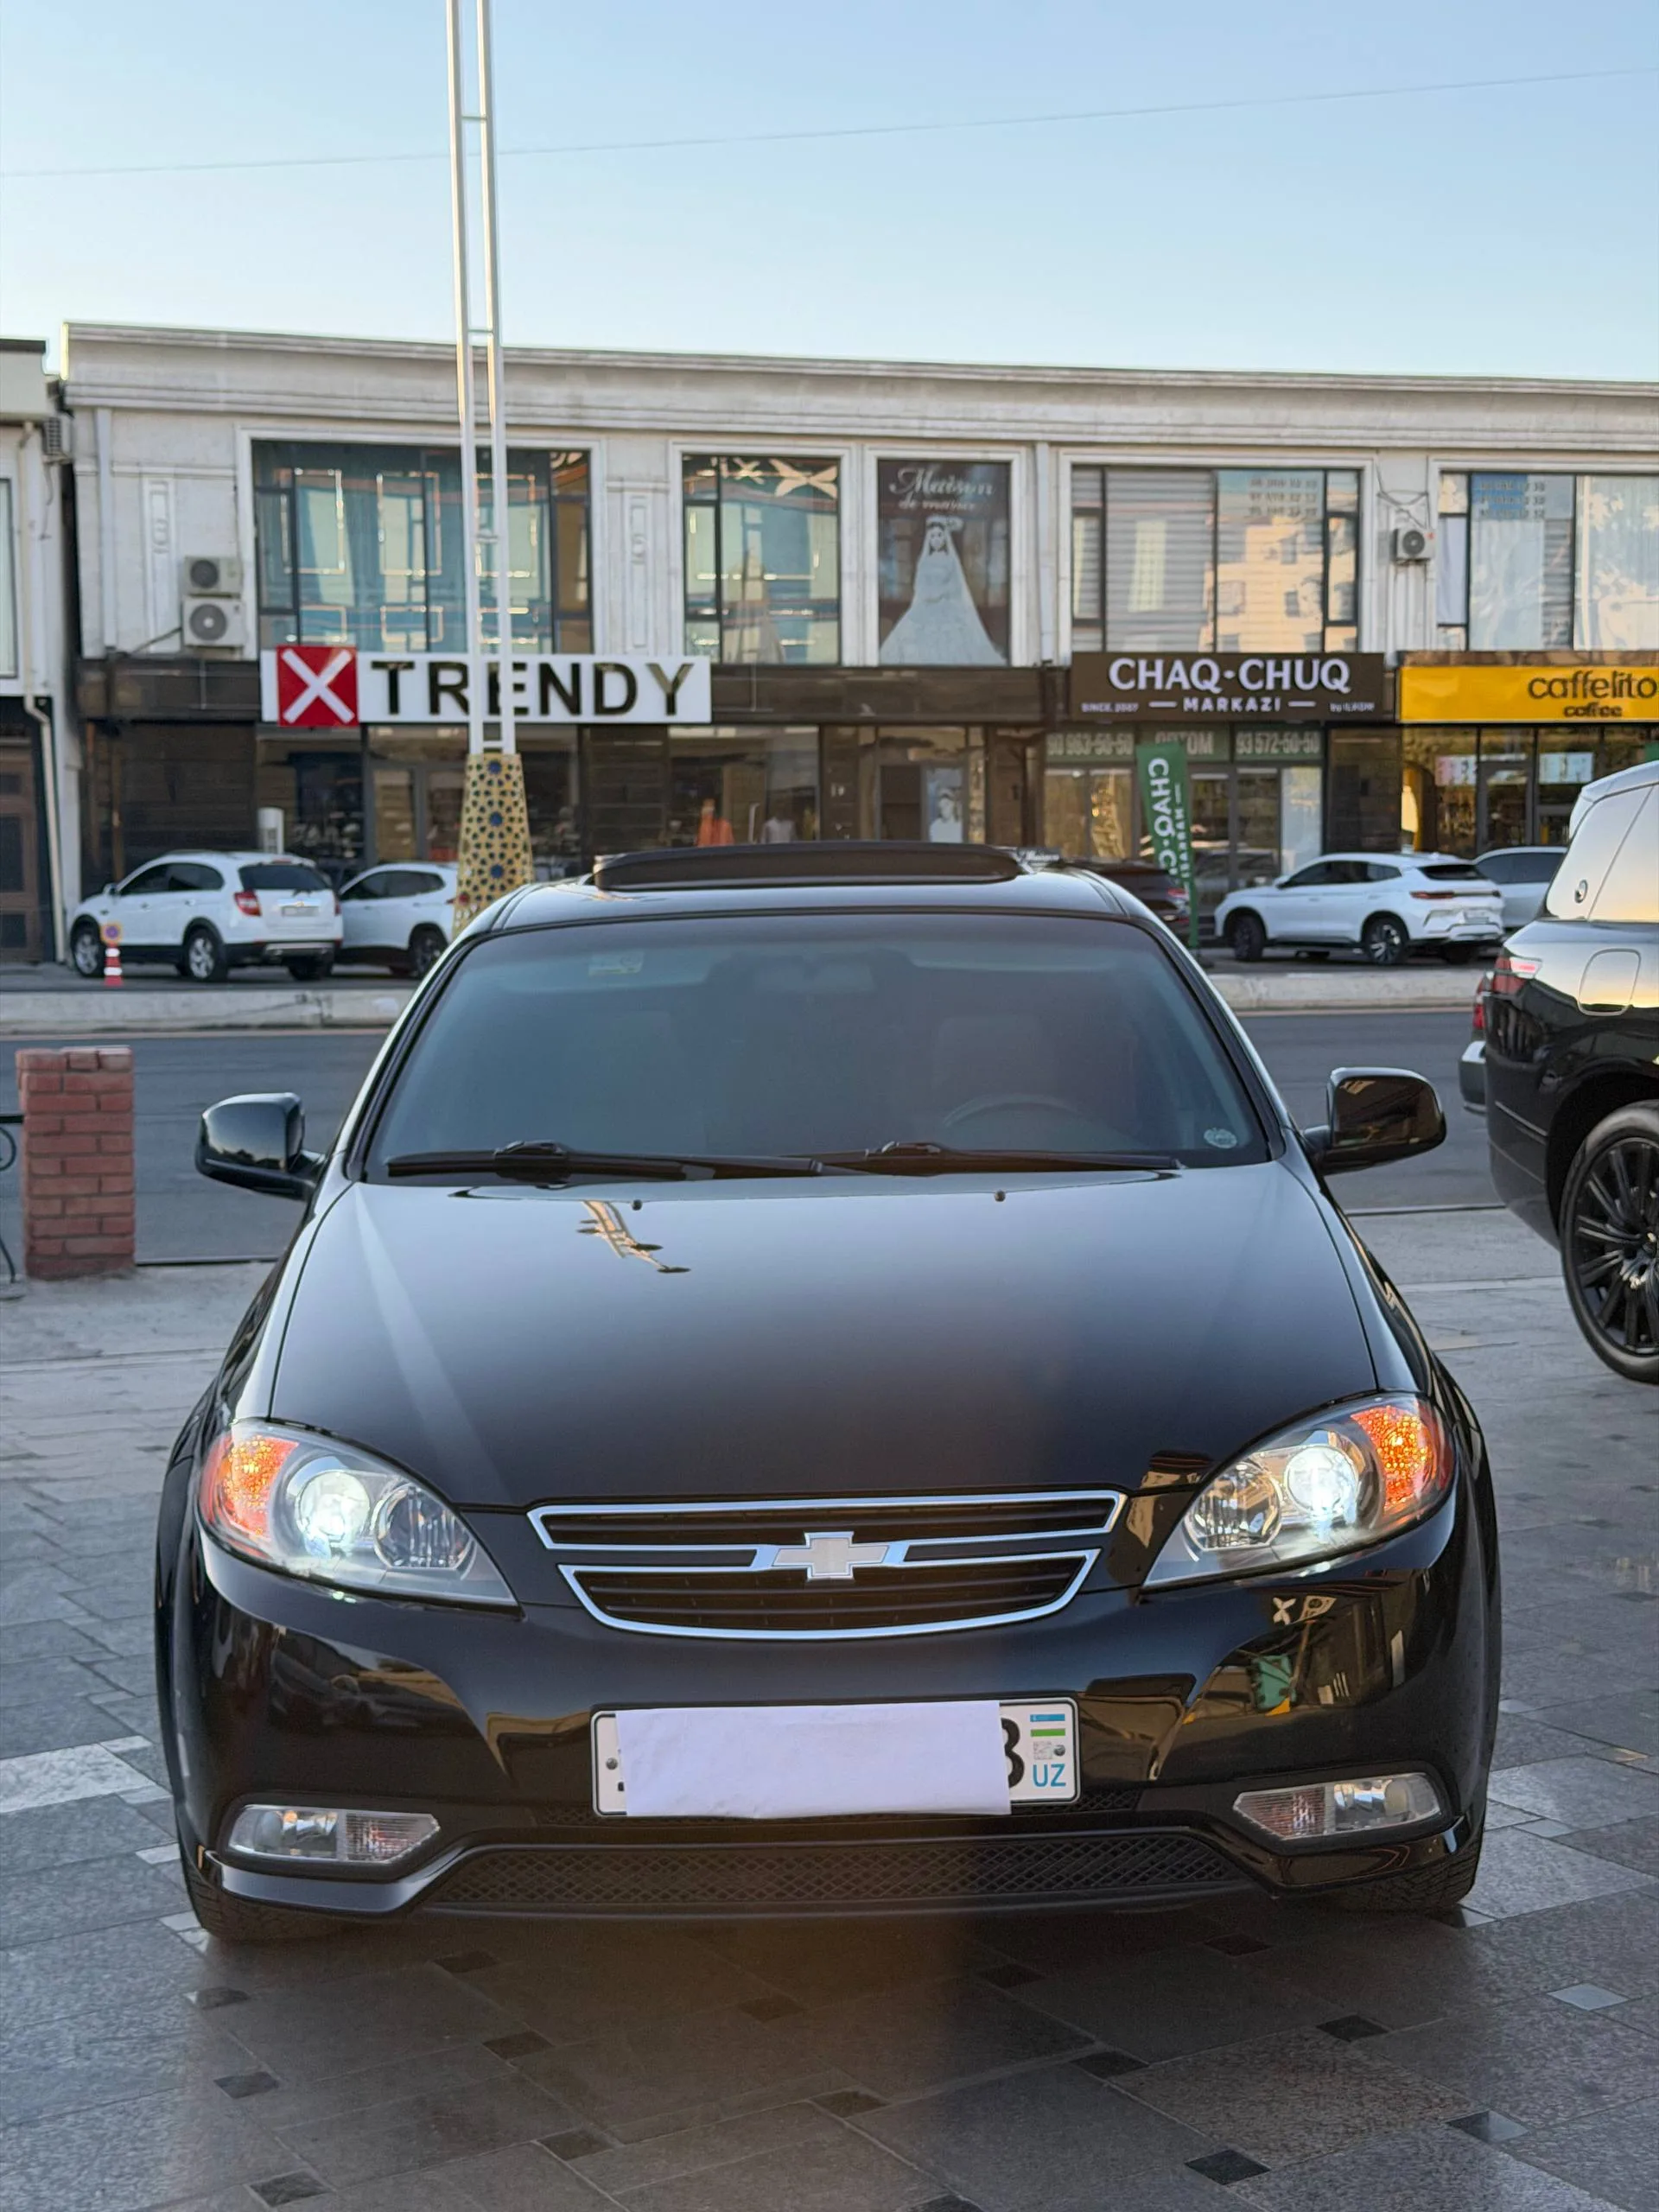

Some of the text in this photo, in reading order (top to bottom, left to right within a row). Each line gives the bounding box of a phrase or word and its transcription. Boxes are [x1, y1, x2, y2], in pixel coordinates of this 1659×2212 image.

[372, 661, 696, 716] TRENDY
[1528, 670, 1658, 699] caffelito
[1183, 696, 1281, 713] MARKAZI
[1564, 701, 1623, 717] coffee
[1033, 1764, 1066, 1787] UZ
